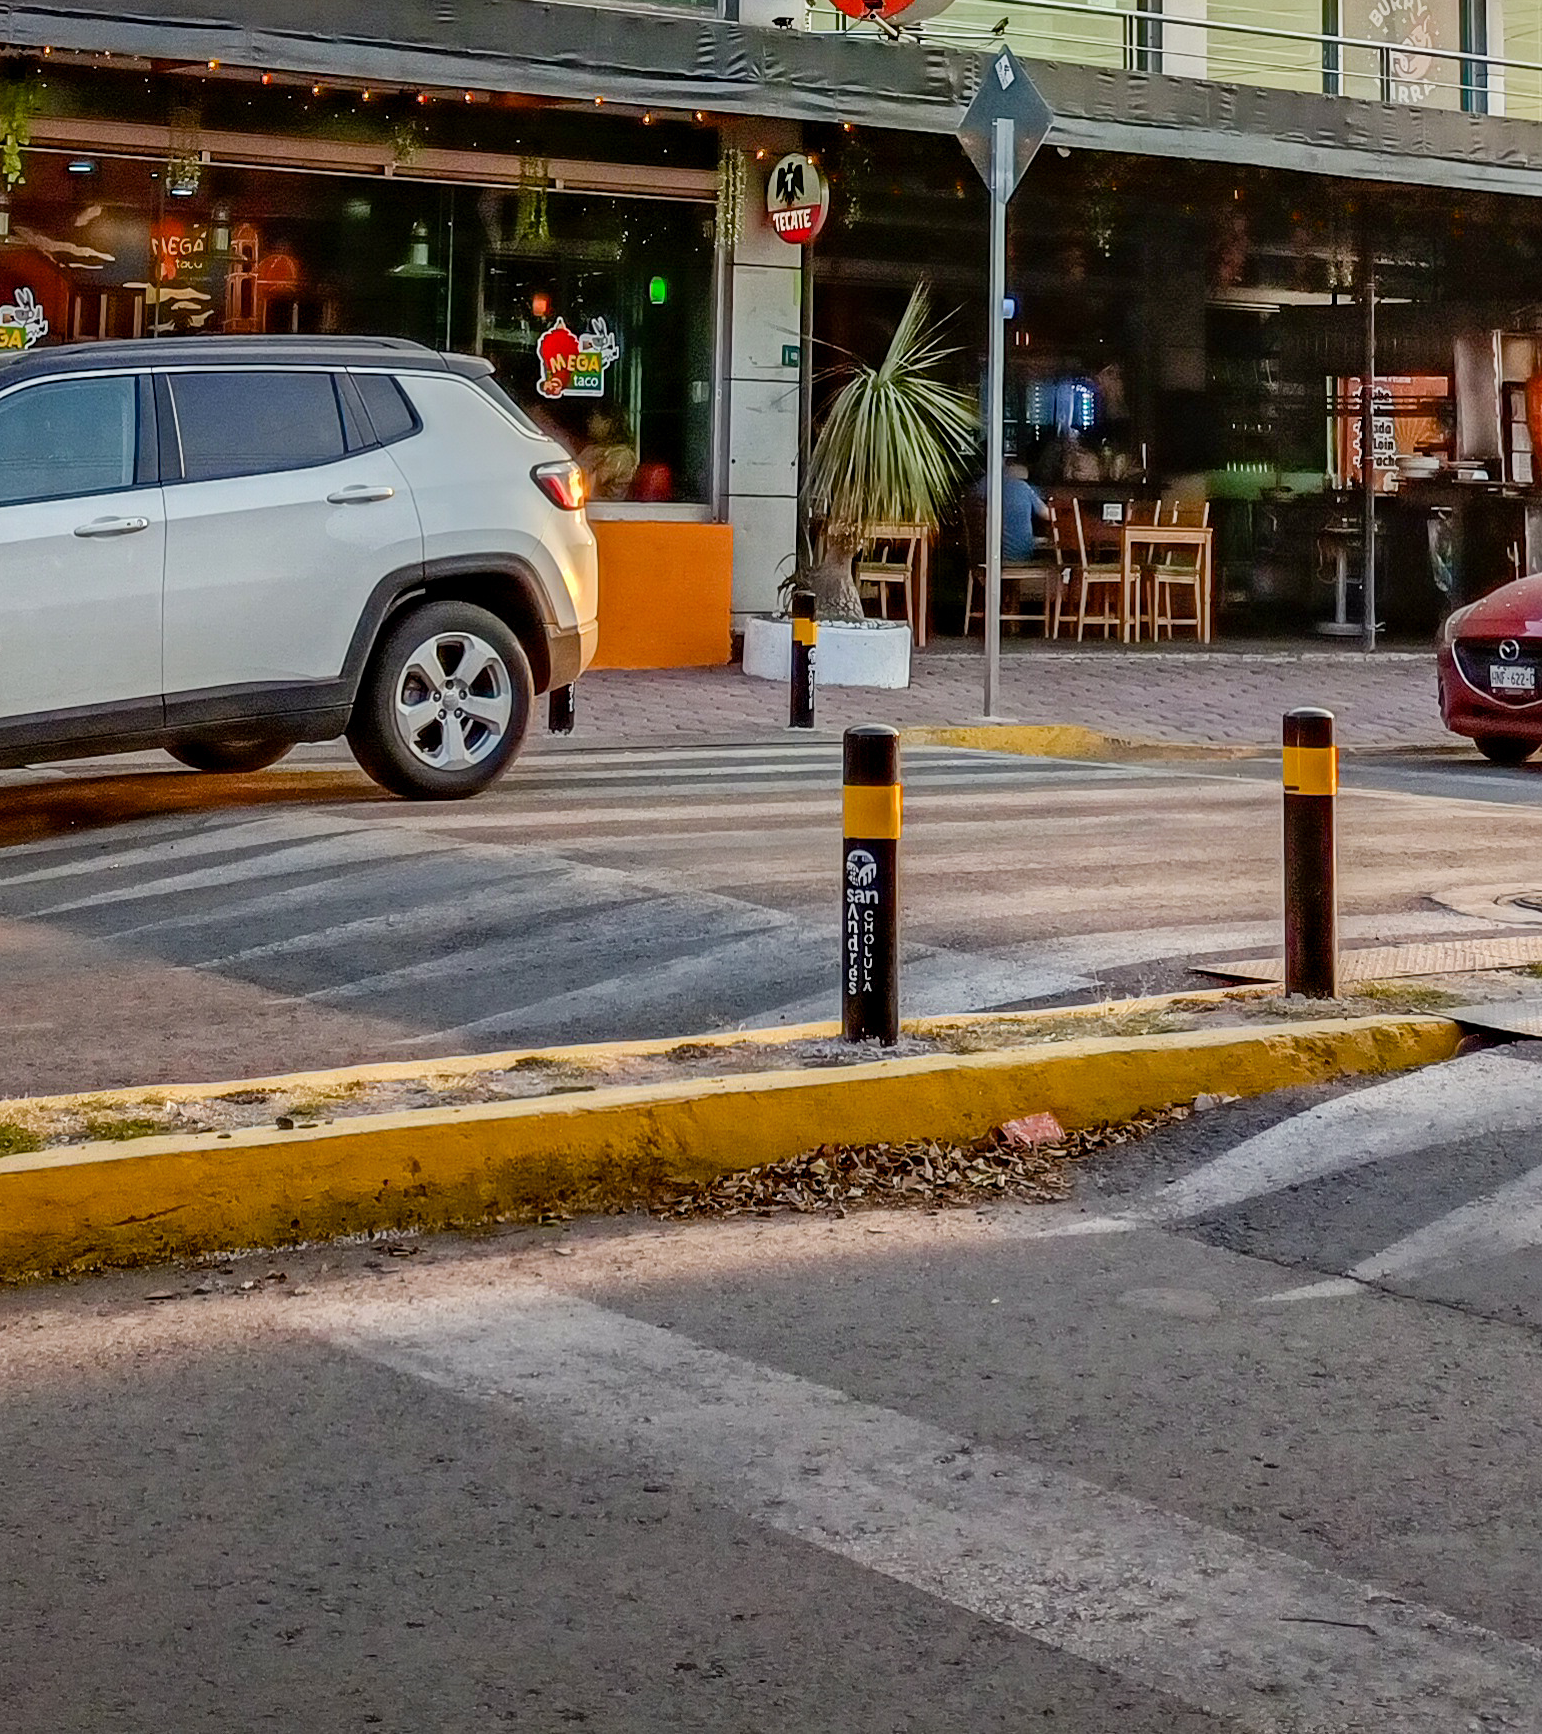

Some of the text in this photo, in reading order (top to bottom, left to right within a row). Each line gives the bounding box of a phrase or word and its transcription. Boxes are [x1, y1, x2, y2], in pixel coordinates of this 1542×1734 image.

[1374, 77, 1436, 103] IRRY
[772, 207, 812, 233] TECATE
[549, 352, 600, 374] MEGA
[573, 374, 599, 387] taco
[846, 888, 879, 905] san
[862, 910, 874, 992] CHOLULA
